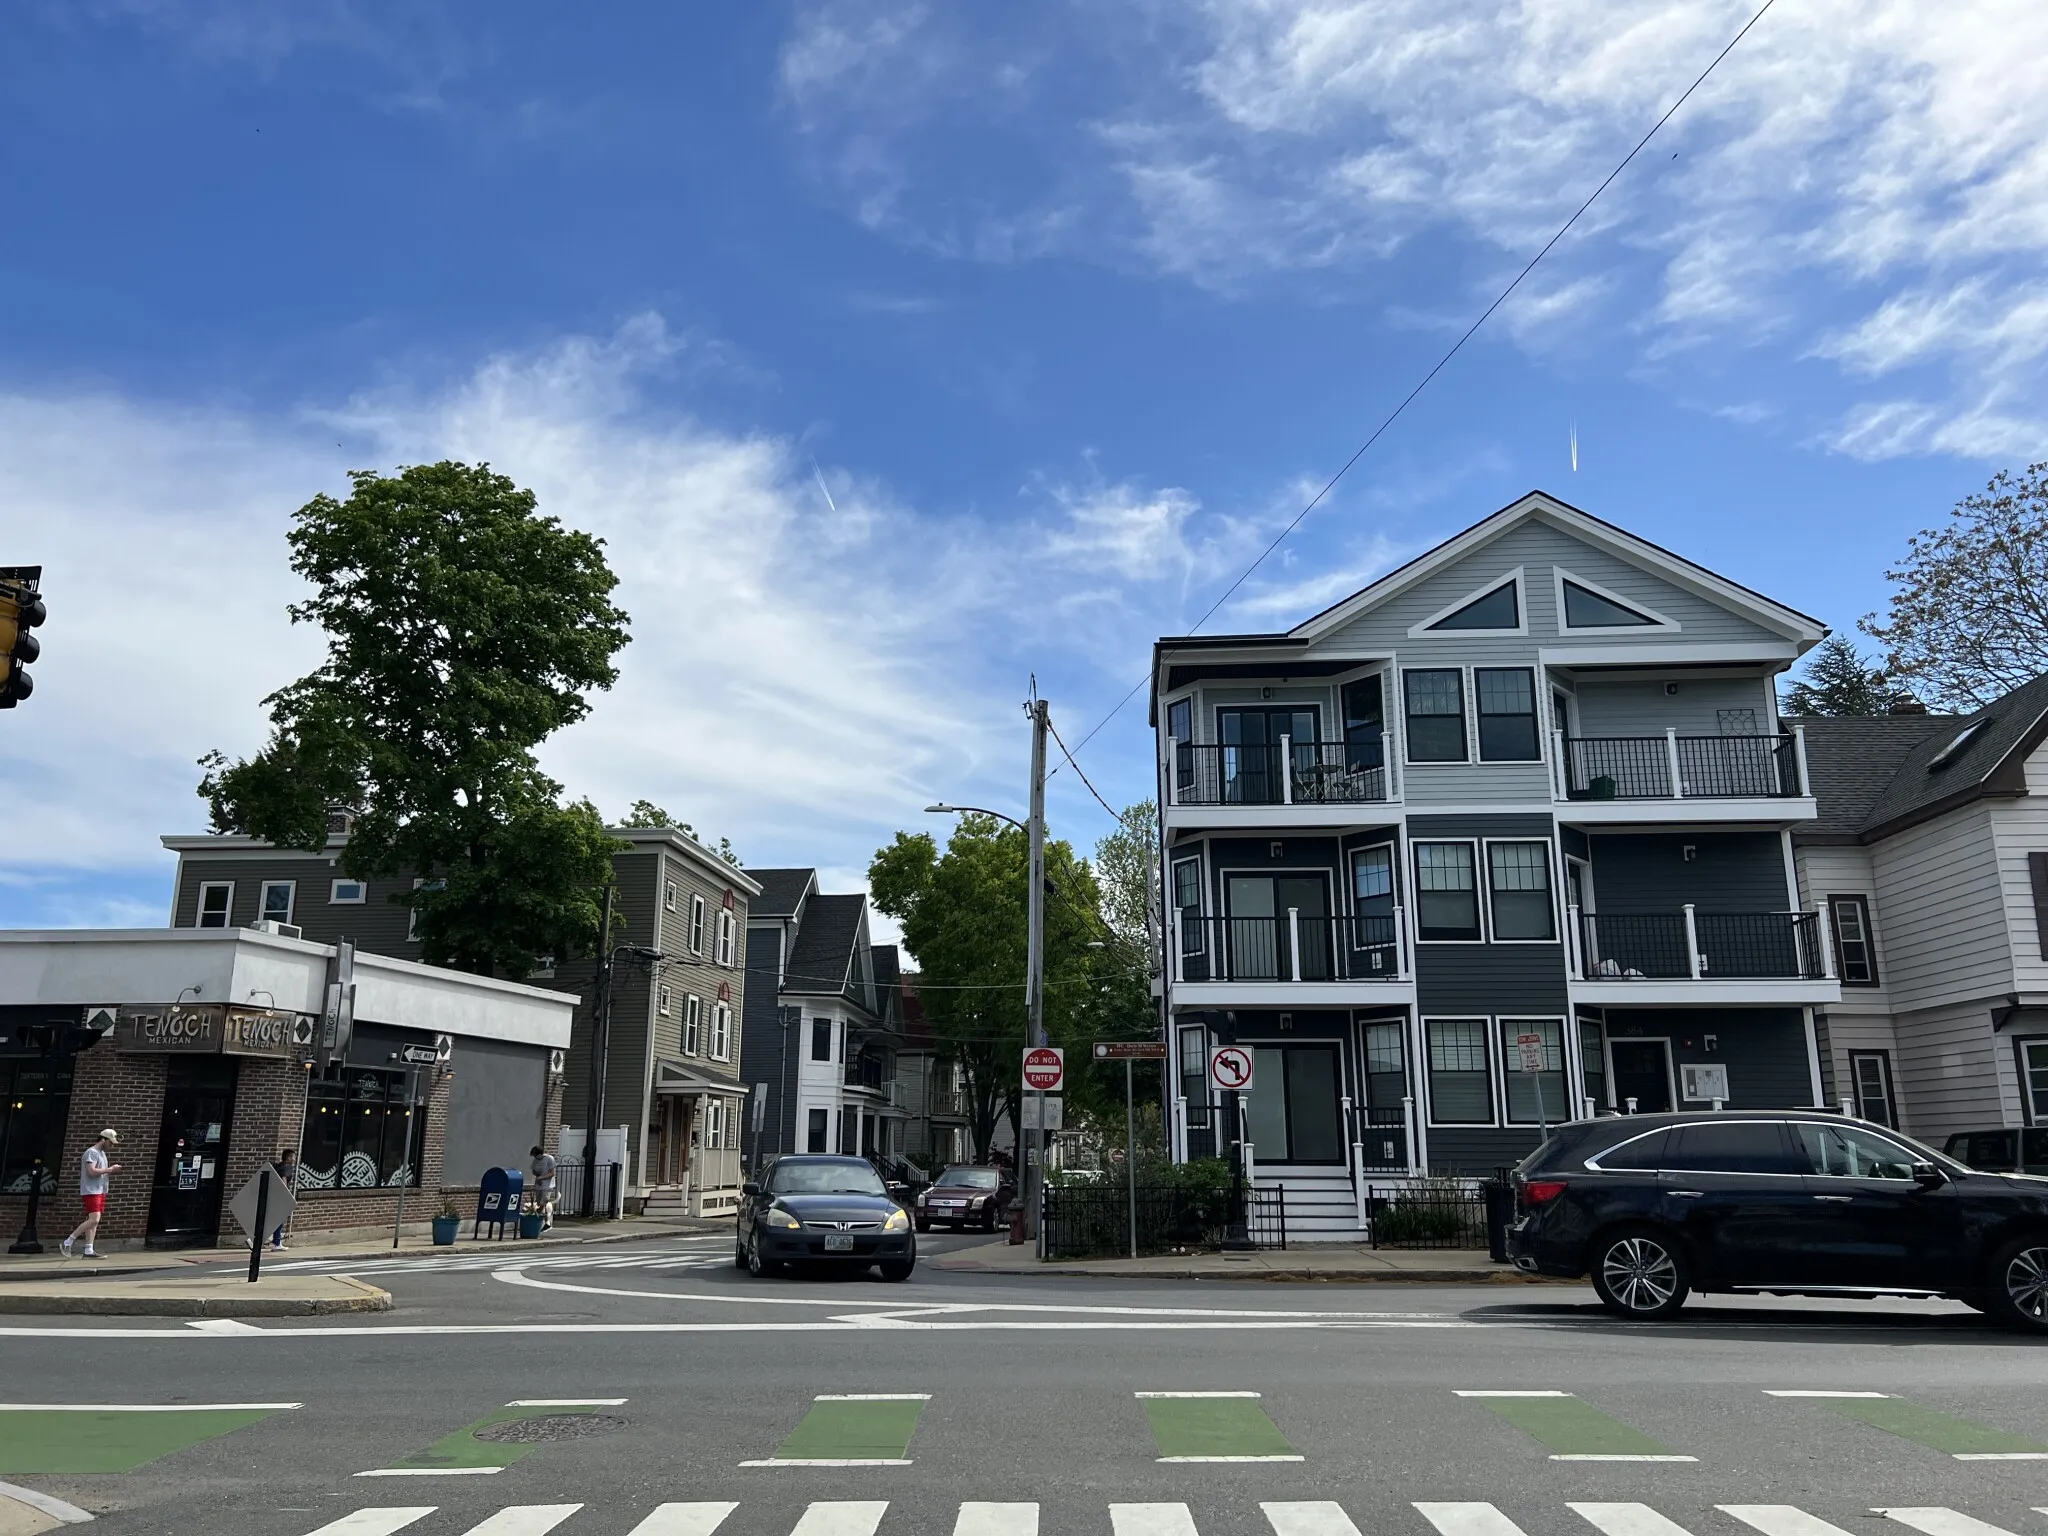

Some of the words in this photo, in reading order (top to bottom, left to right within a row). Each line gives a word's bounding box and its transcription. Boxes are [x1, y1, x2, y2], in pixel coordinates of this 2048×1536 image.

[148, 1036, 191, 1045] MEXICAN
[244, 1039, 275, 1049] MEXICAN
[412, 1051, 423, 1059] ONE
[423, 1052, 436, 1060] WAY
[1029, 1056, 1039, 1064] DO
[1042, 1056, 1057, 1064] NOT
[1031, 1074, 1054, 1082] ENTER
